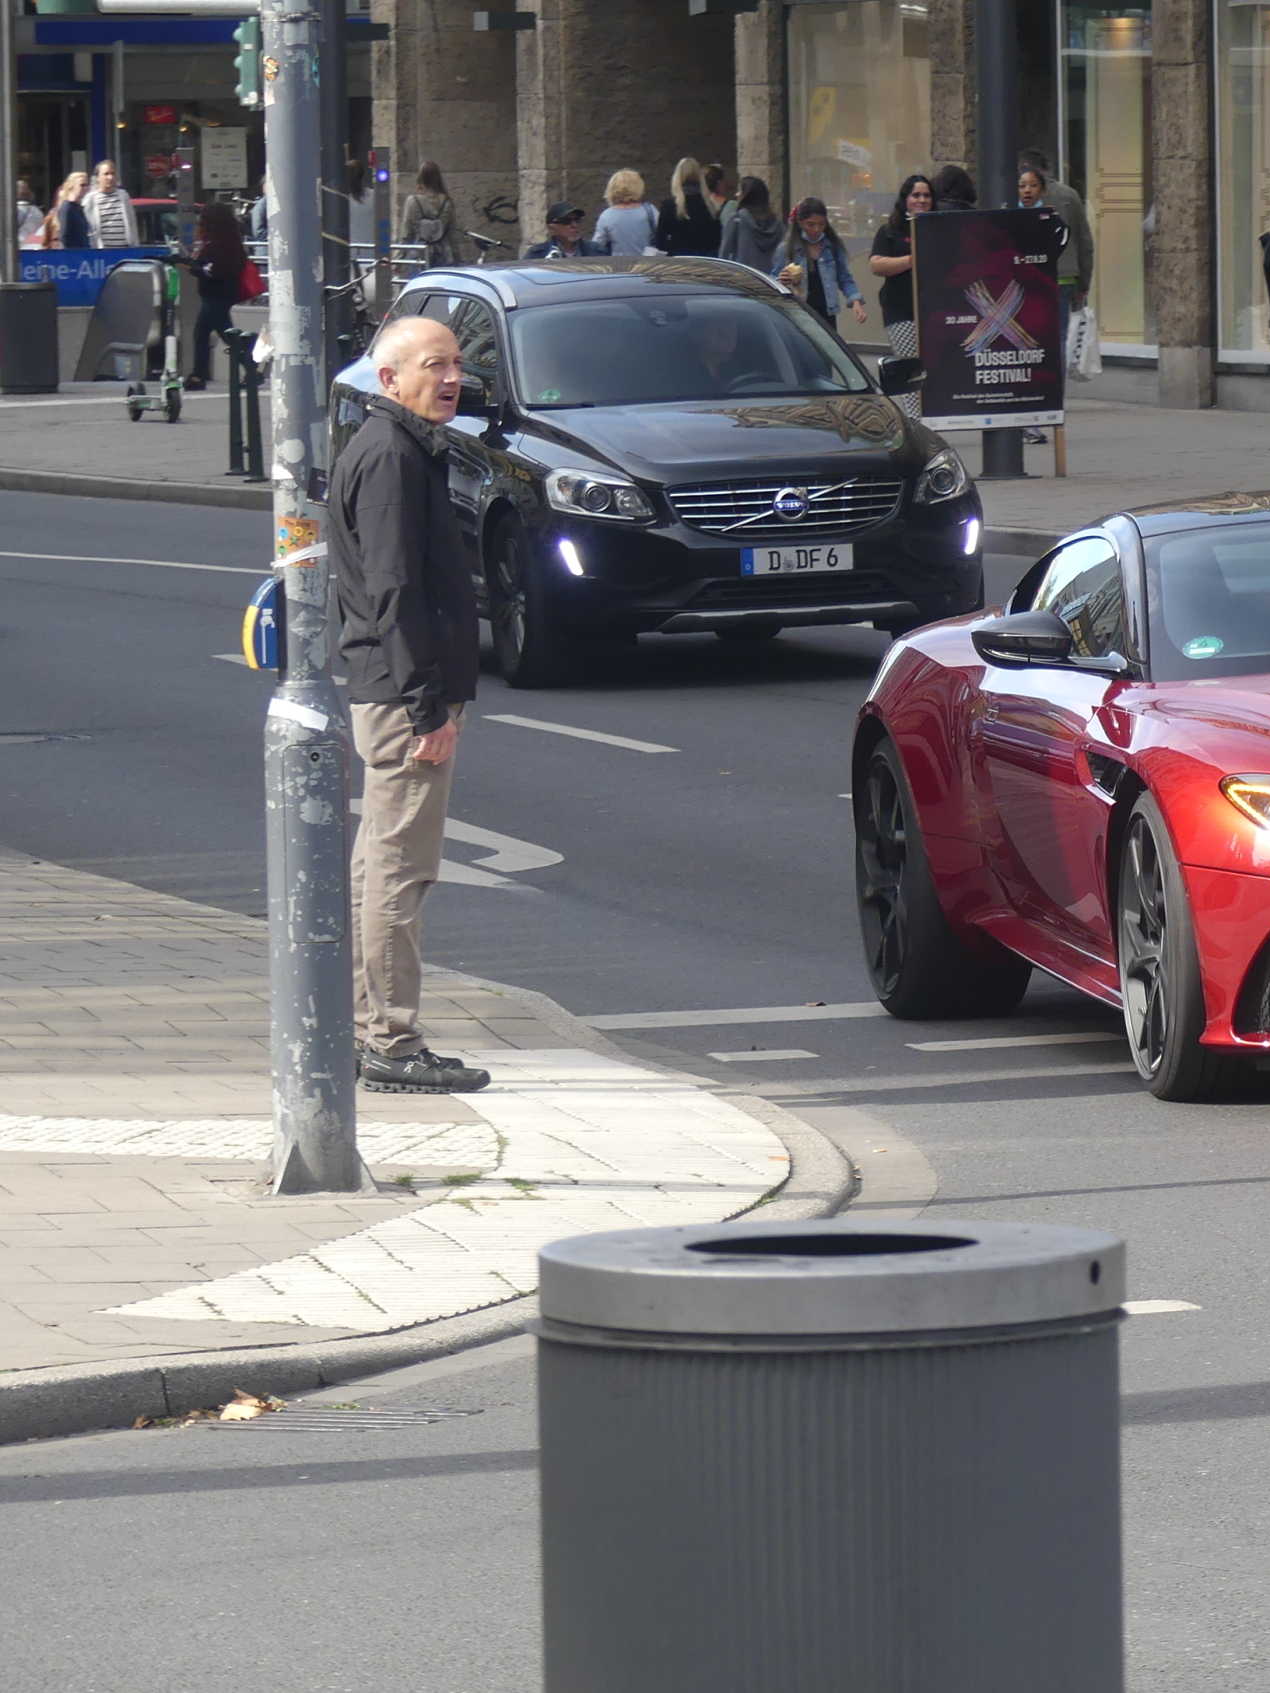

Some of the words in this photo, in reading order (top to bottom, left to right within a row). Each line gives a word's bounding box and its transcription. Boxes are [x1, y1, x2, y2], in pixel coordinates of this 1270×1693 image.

[975, 348, 1046, 367] DÜSSELDORF
[975, 367, 1032, 385] FESTIVAL!
[776, 500, 807, 509] VOLVO
[768, 551, 781, 571] D
[796, 548, 821, 570] DF
[826, 547, 839, 568] 6
